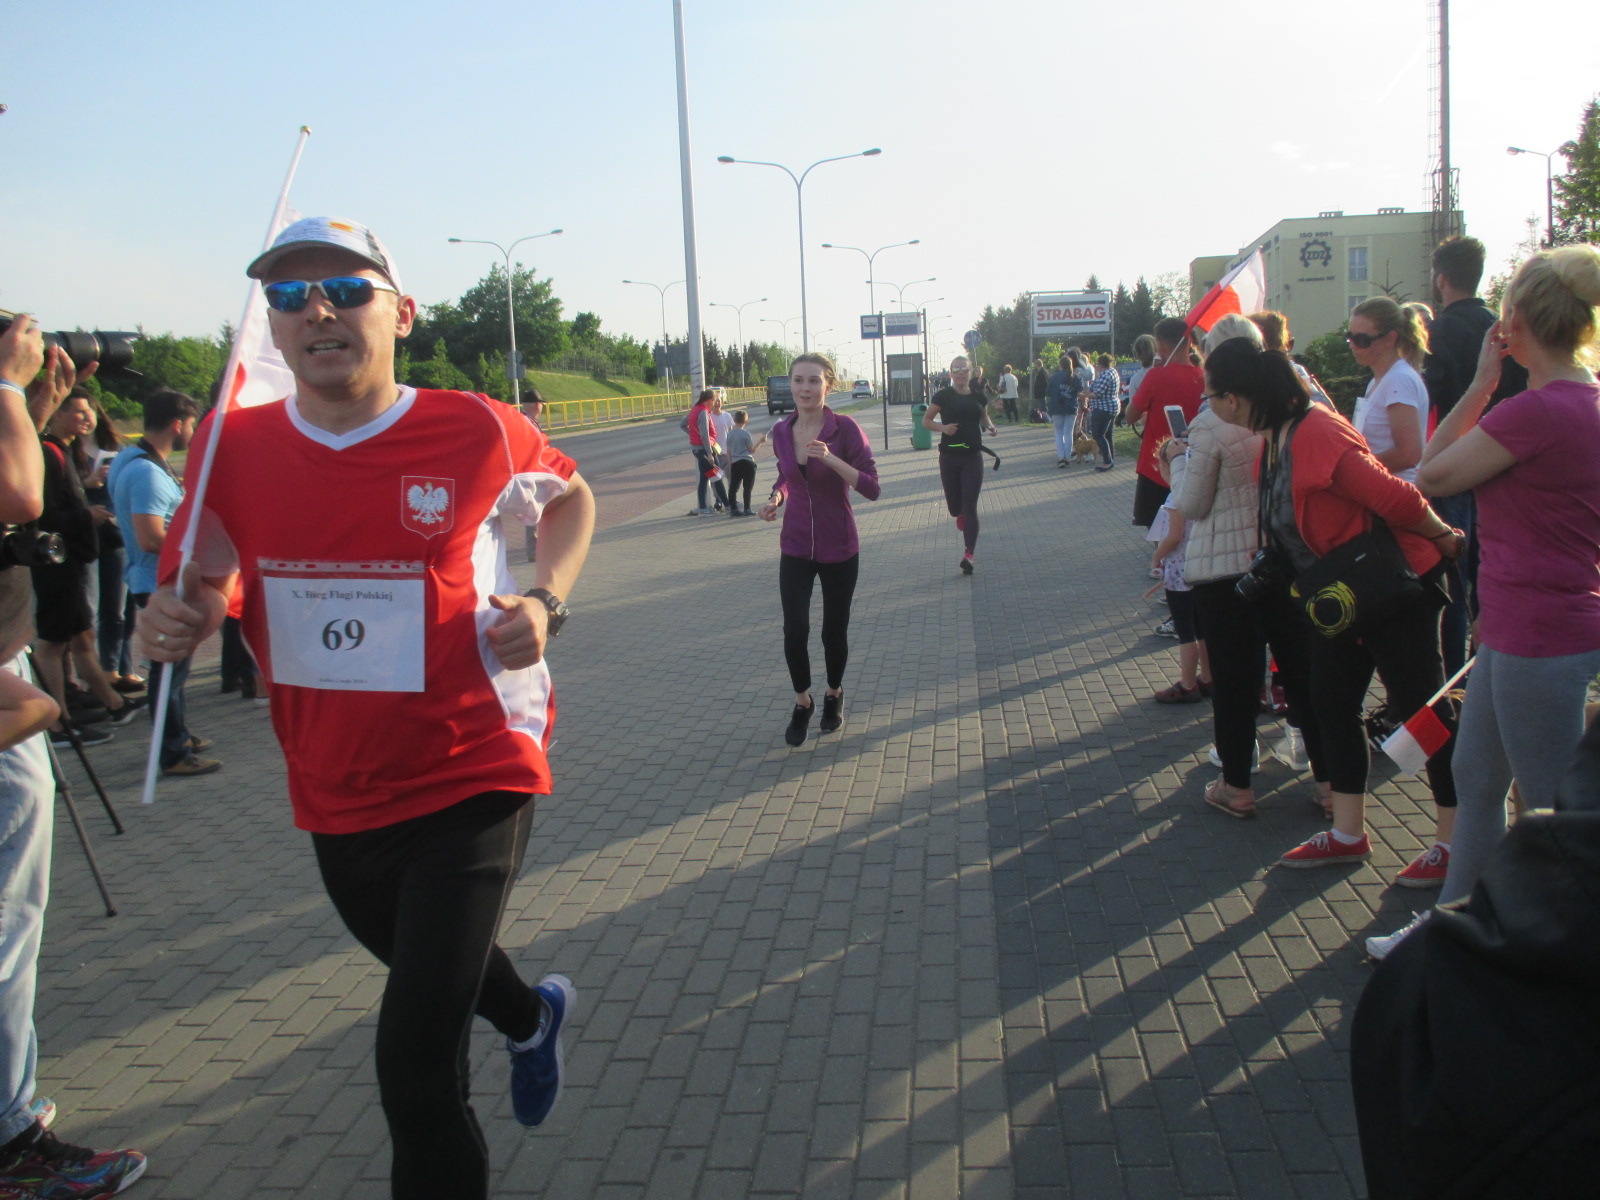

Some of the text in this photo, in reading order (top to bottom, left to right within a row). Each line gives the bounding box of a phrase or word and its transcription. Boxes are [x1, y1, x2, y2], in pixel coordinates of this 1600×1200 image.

[1306, 251, 1327, 260] ZDZ
[1037, 307, 1106, 321] STRABAG
[329, 590, 354, 600] Flagi
[356, 590, 393, 601] Polskiej
[322, 618, 365, 651] 69
